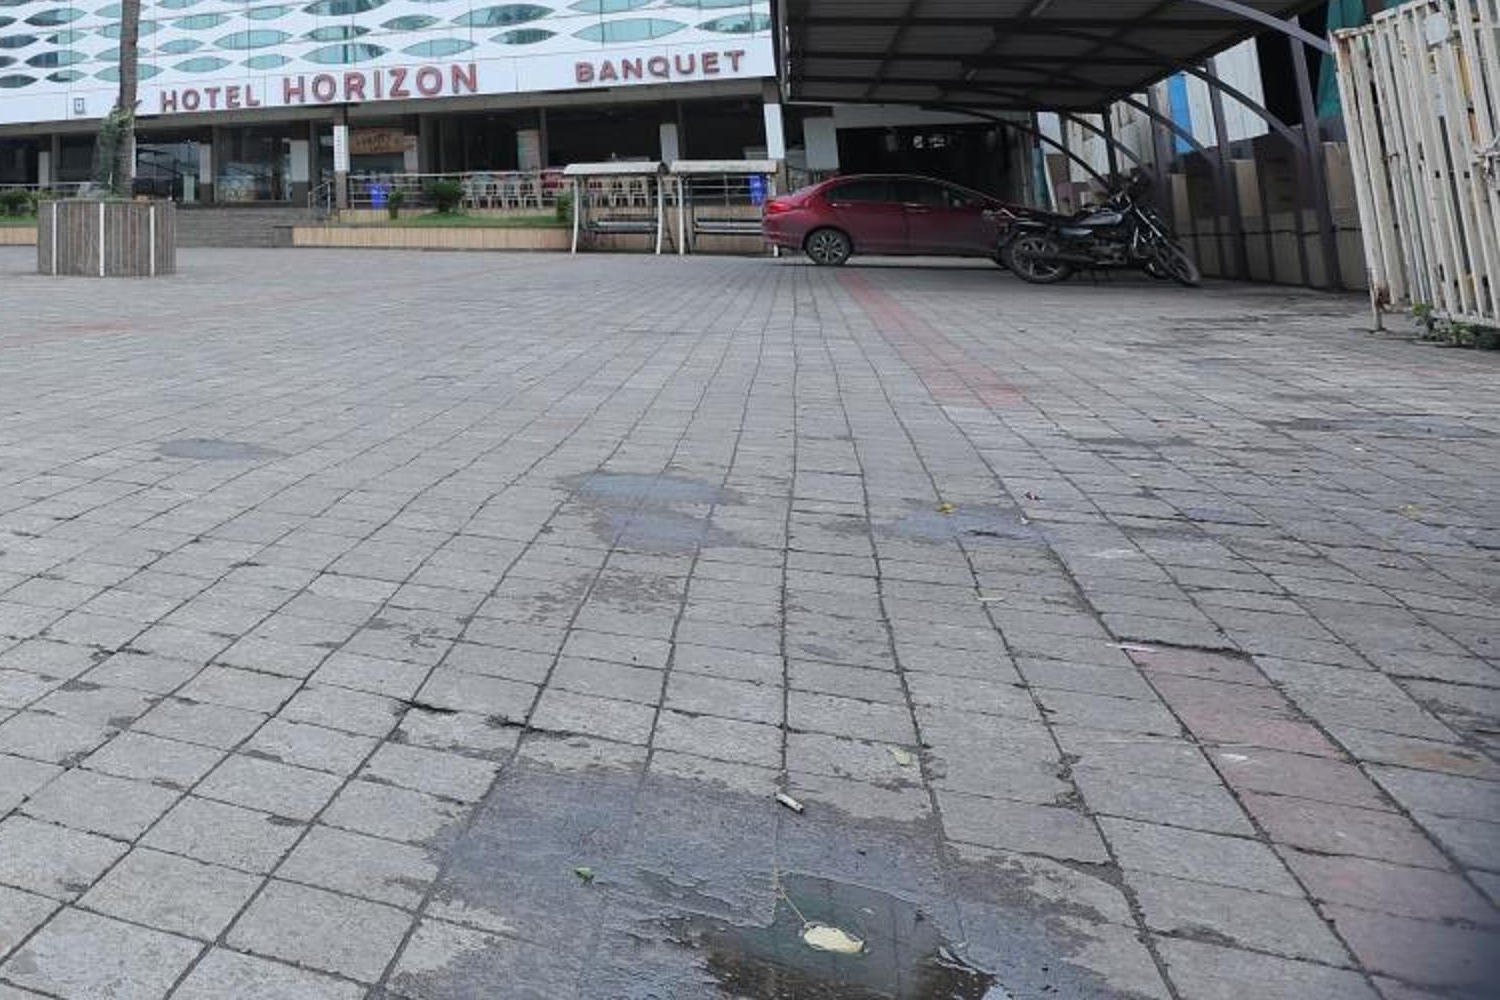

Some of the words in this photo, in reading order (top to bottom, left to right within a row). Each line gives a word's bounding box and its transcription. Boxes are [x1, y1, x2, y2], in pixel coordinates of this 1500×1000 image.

[575, 49, 746, 83] BANQUET
[160, 83, 260, 112] HOTEL
[283, 63, 478, 104] HORIZON
